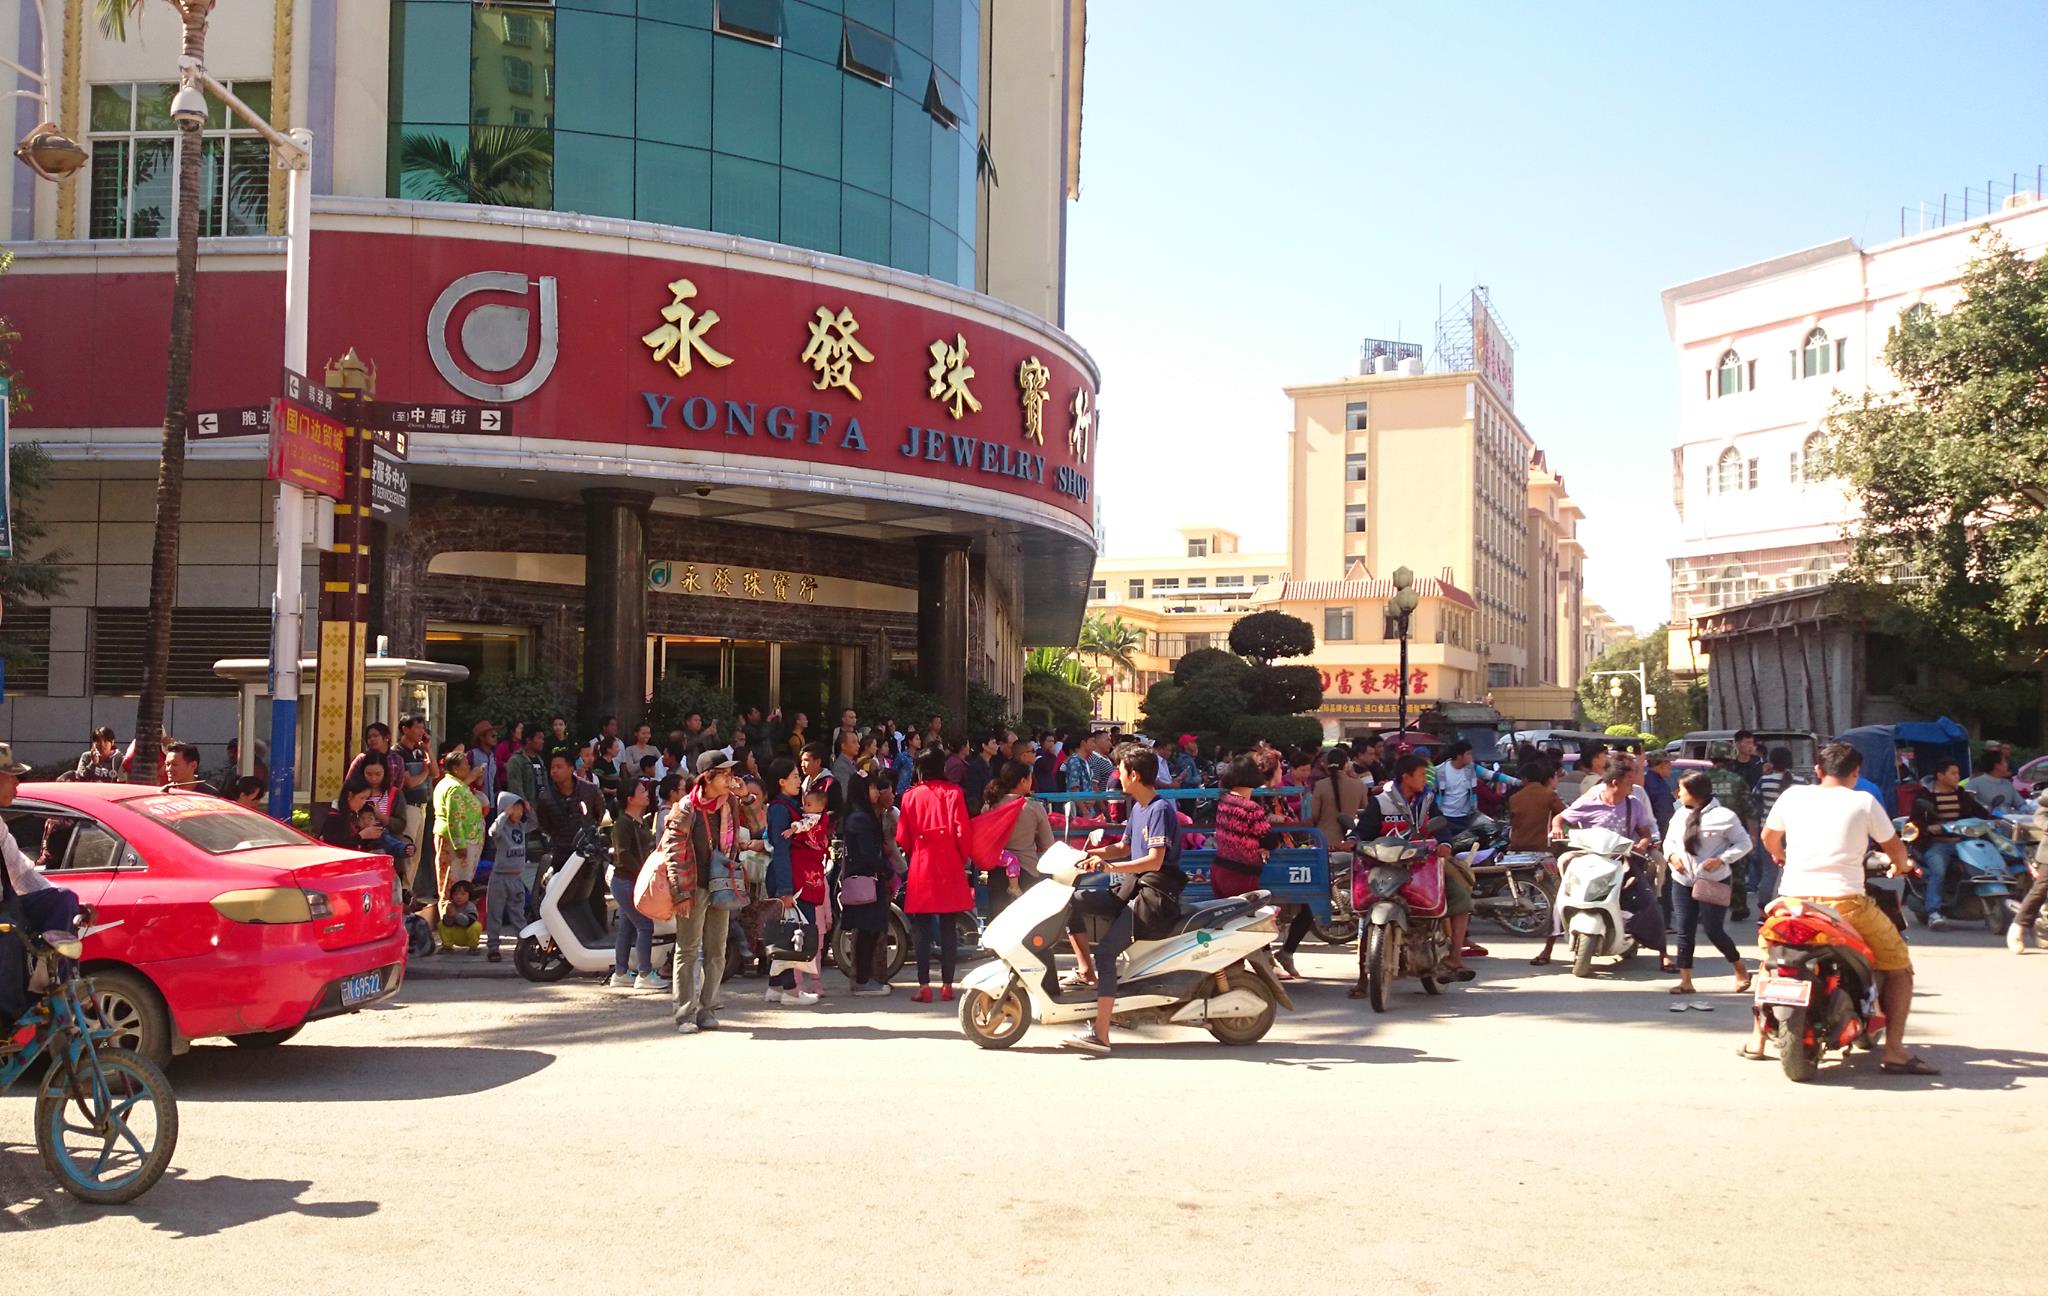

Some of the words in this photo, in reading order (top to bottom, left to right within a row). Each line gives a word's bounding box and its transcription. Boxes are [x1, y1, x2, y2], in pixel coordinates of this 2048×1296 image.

[641, 278, 1092, 463] 永發珠寶行
[286, 407, 344, 454] 国门边贸城
[641, 391, 871, 452] YONGFA
[901, 425, 1047, 485] JEWELRY
[1057, 464, 1090, 505] SHOP
[680, 564, 819, 603] 永發珠寶行
[1335, 668, 1428, 694] 富豪珠宝
[1288, 866, 1312, 884] 动
